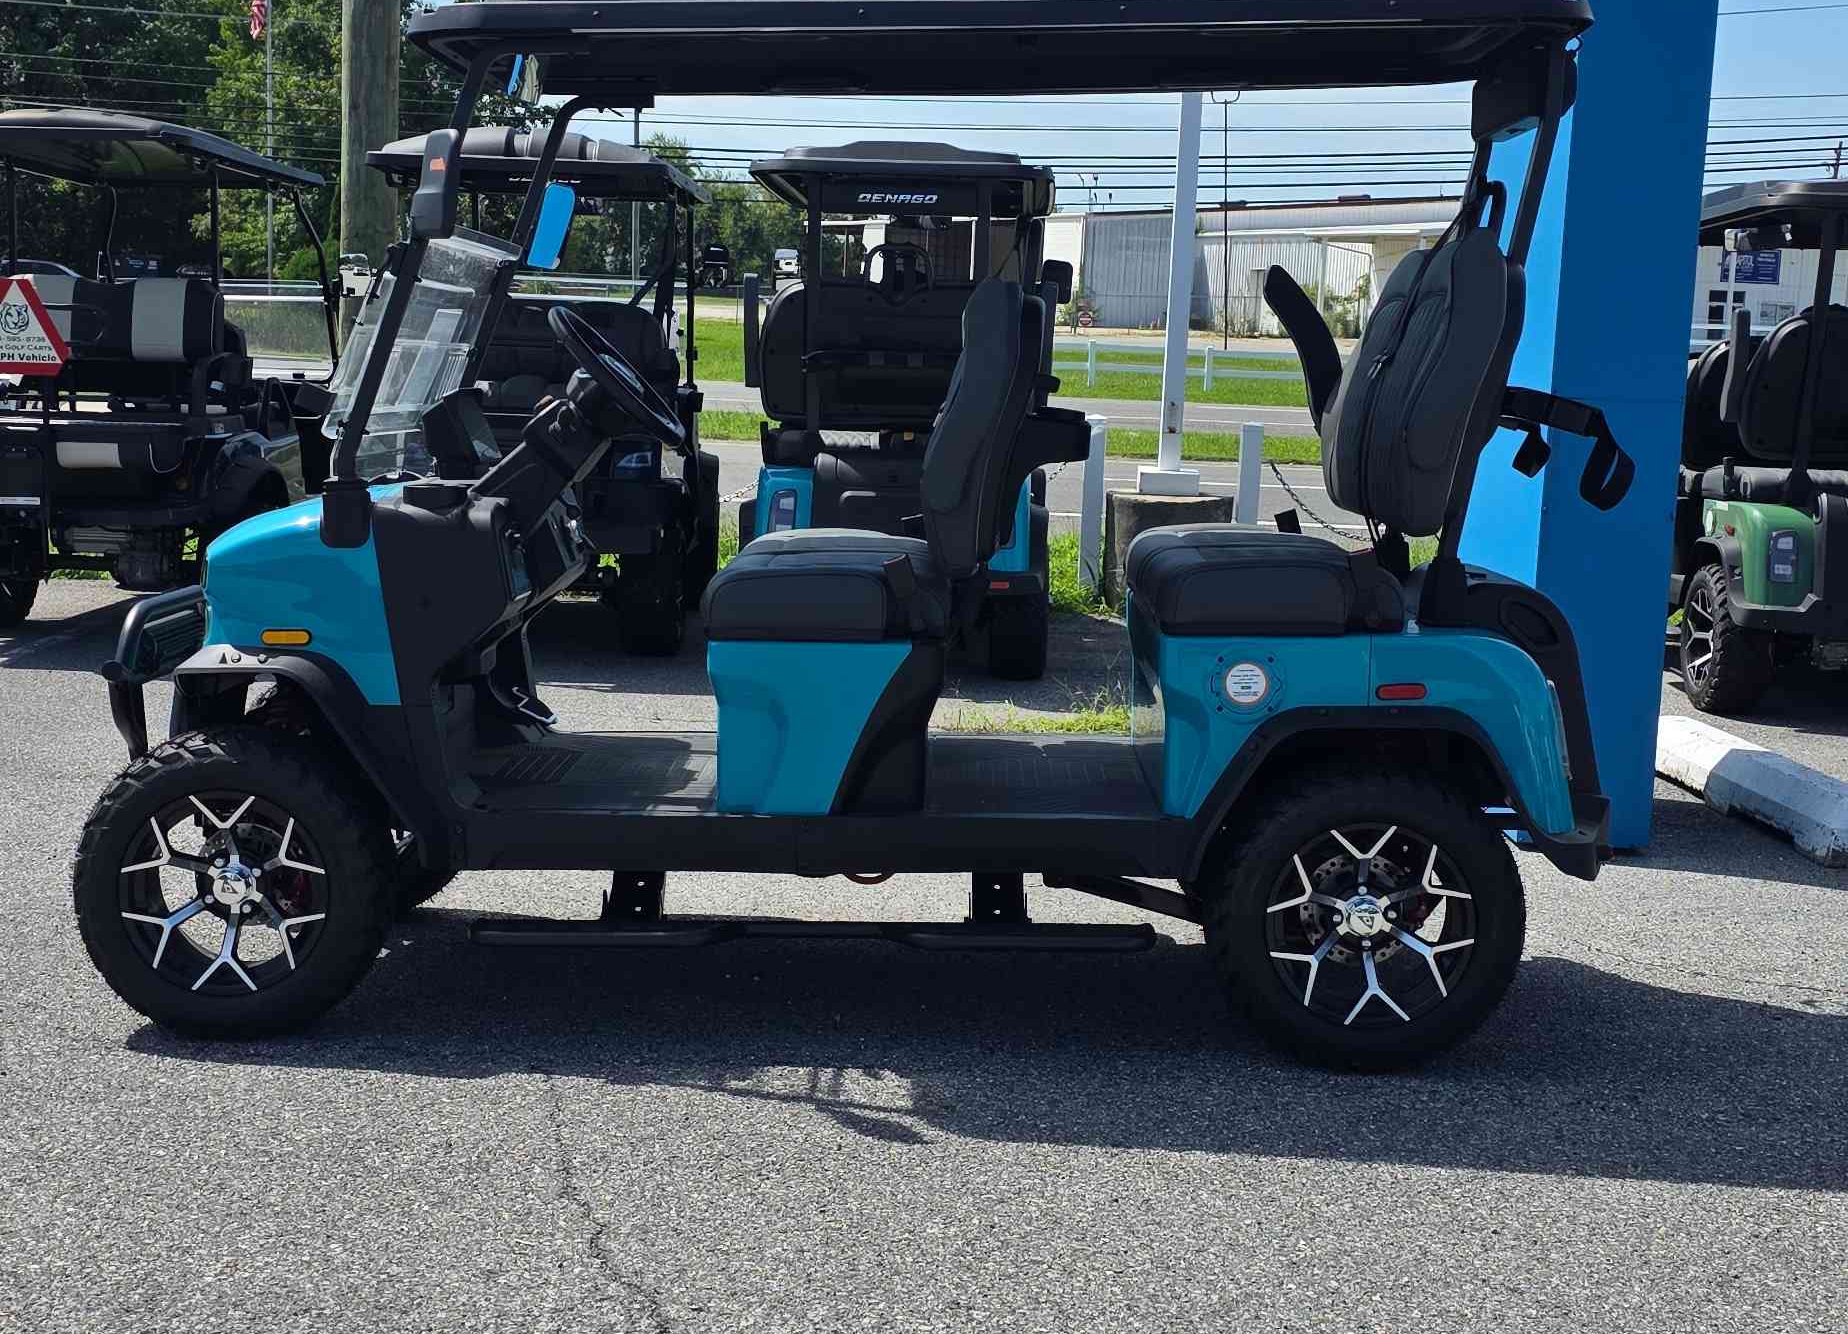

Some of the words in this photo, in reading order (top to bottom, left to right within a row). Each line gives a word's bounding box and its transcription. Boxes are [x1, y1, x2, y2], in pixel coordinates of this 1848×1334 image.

[857, 193, 938, 204] DENAGO
[0, 352, 14, 361] PH
[18, 353, 56, 362] Vehicle
